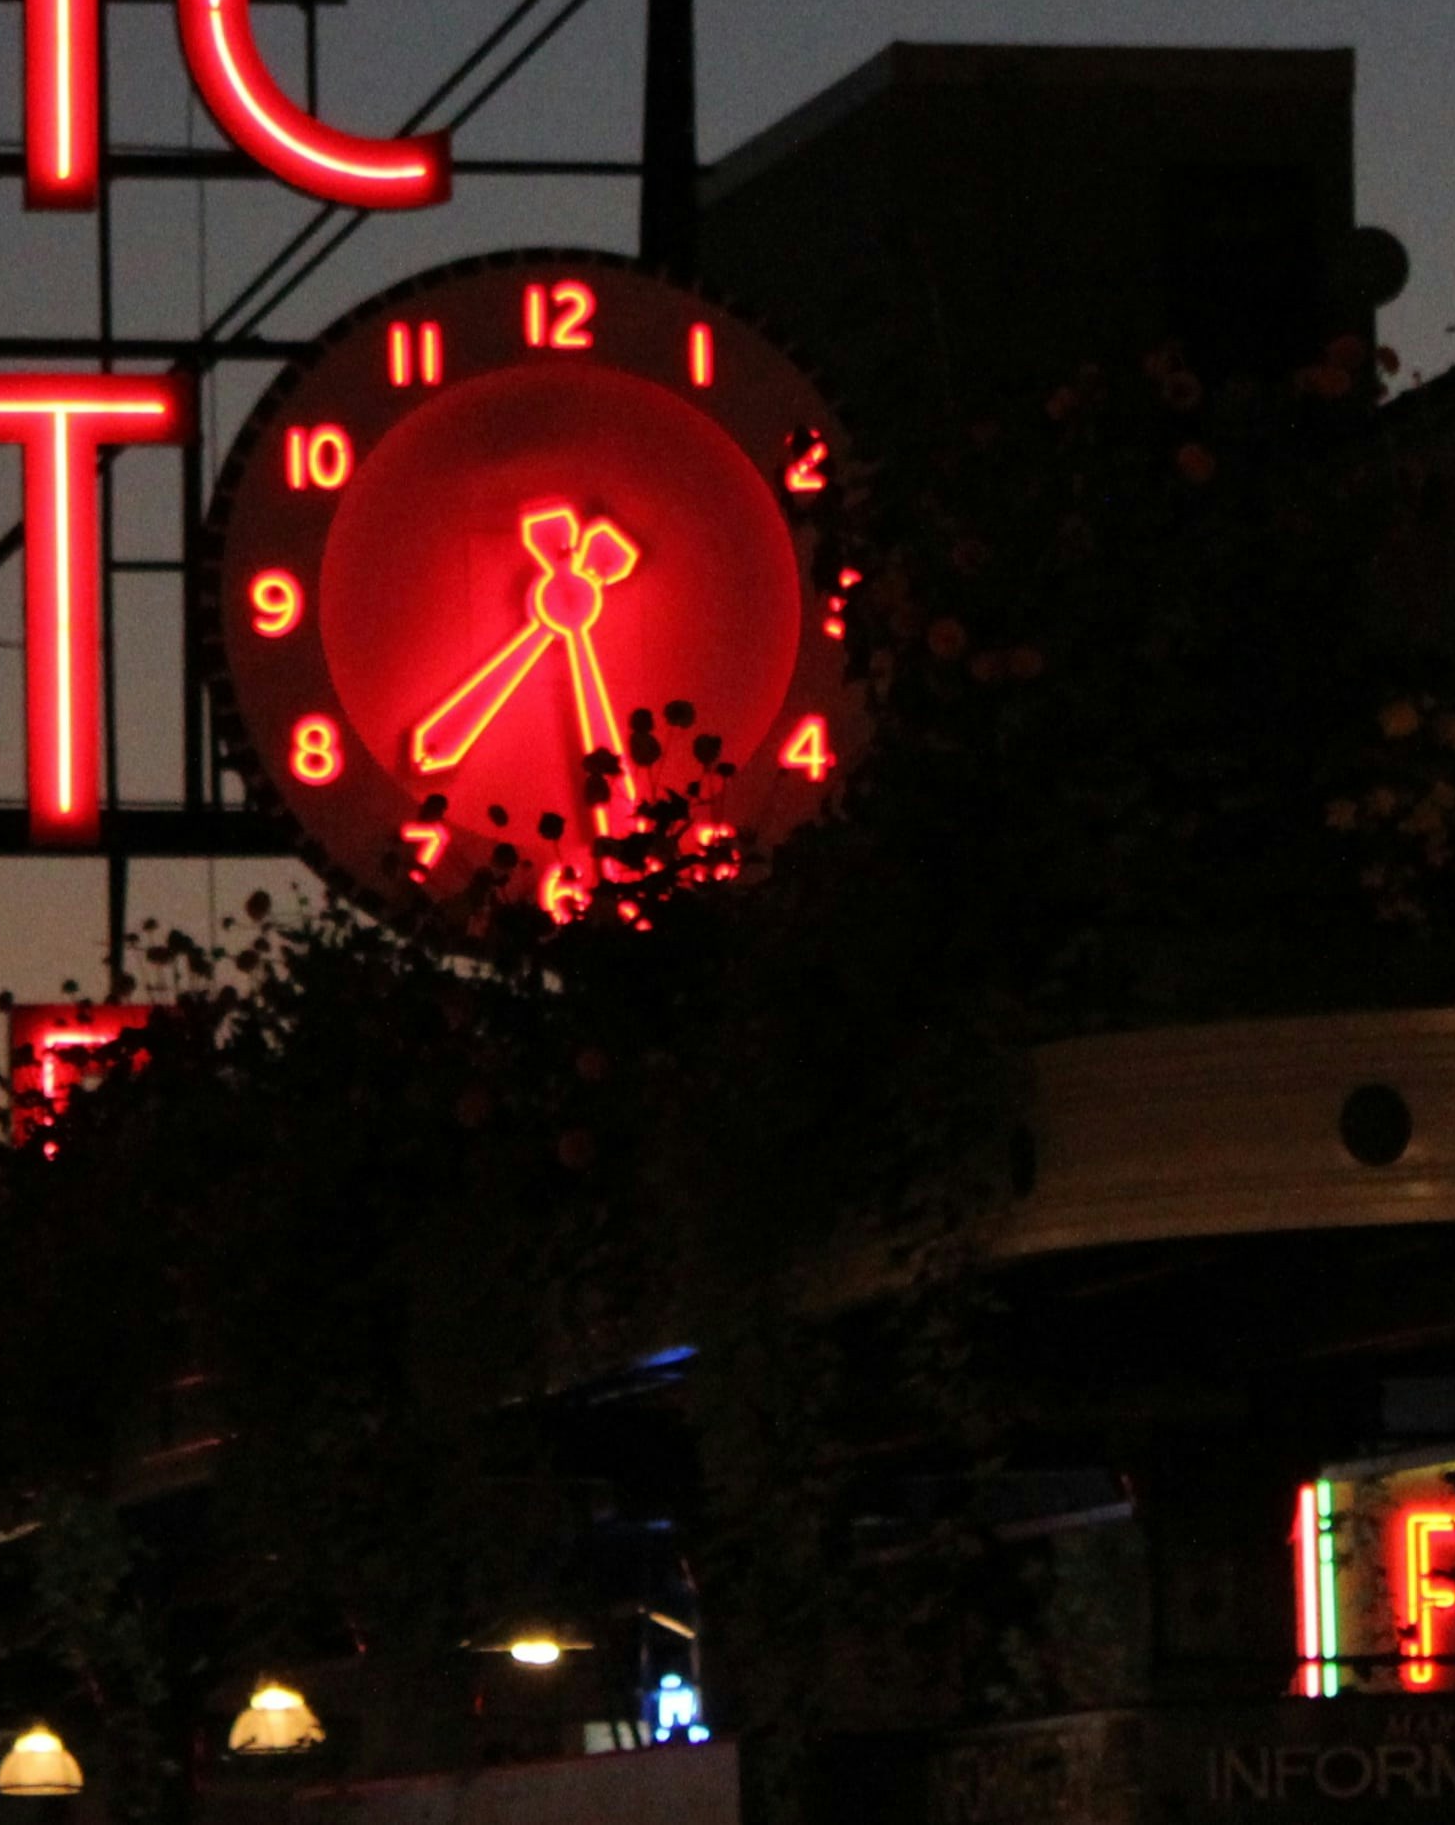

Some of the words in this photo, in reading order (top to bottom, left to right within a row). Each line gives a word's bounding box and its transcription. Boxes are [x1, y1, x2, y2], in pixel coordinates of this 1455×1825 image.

[524, 282, 594, 349] 12
[390, 320, 442, 387] 11
[690, 321, 712, 388] 1
[288, 424, 352, 492] 10
[250, 570, 302, 638] 9
[291, 714, 340, 786] 8
[780, 714, 834, 782] 4
[403, 822, 450, 884] 7
